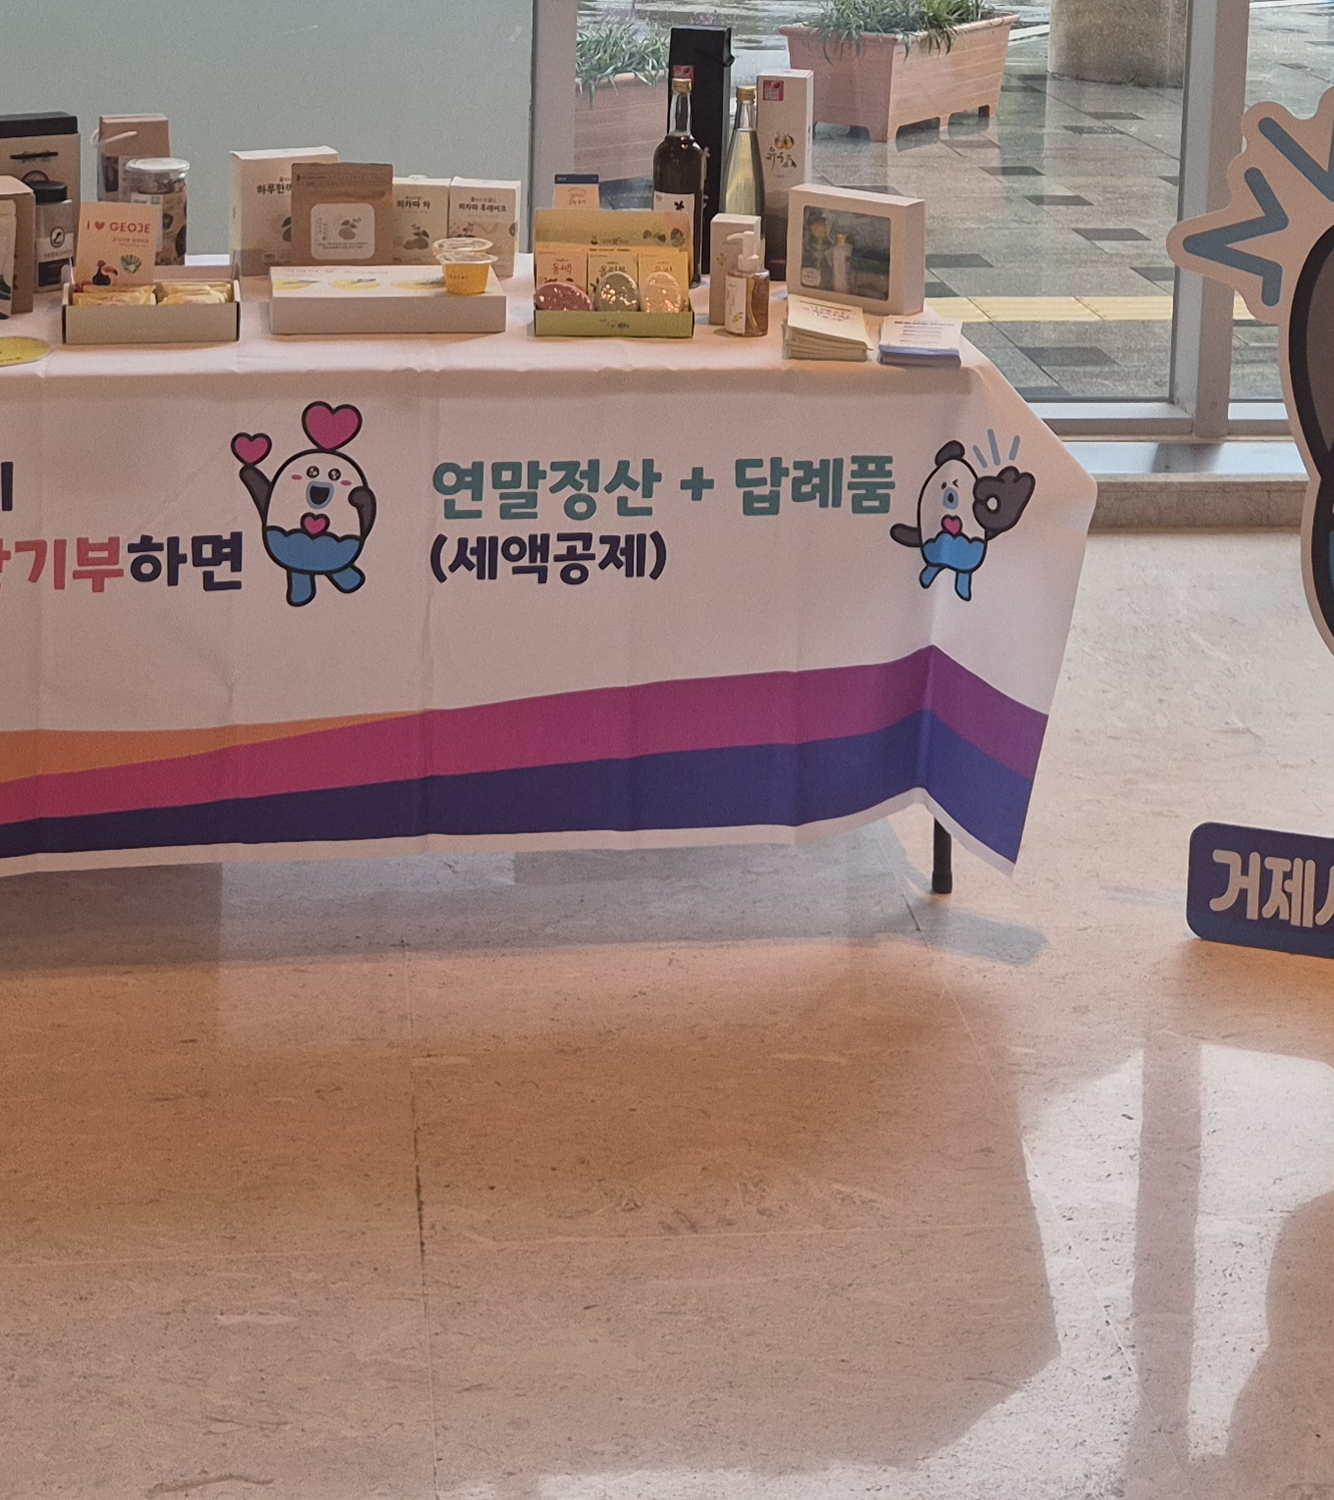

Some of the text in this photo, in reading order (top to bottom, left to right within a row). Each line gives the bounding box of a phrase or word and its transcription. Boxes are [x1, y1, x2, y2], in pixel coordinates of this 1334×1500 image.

[109, 221, 151, 233] GEOJE
[432, 454, 896, 521] 연말정산 + 답례품
[429, 530, 667, 585] (세액공제)
